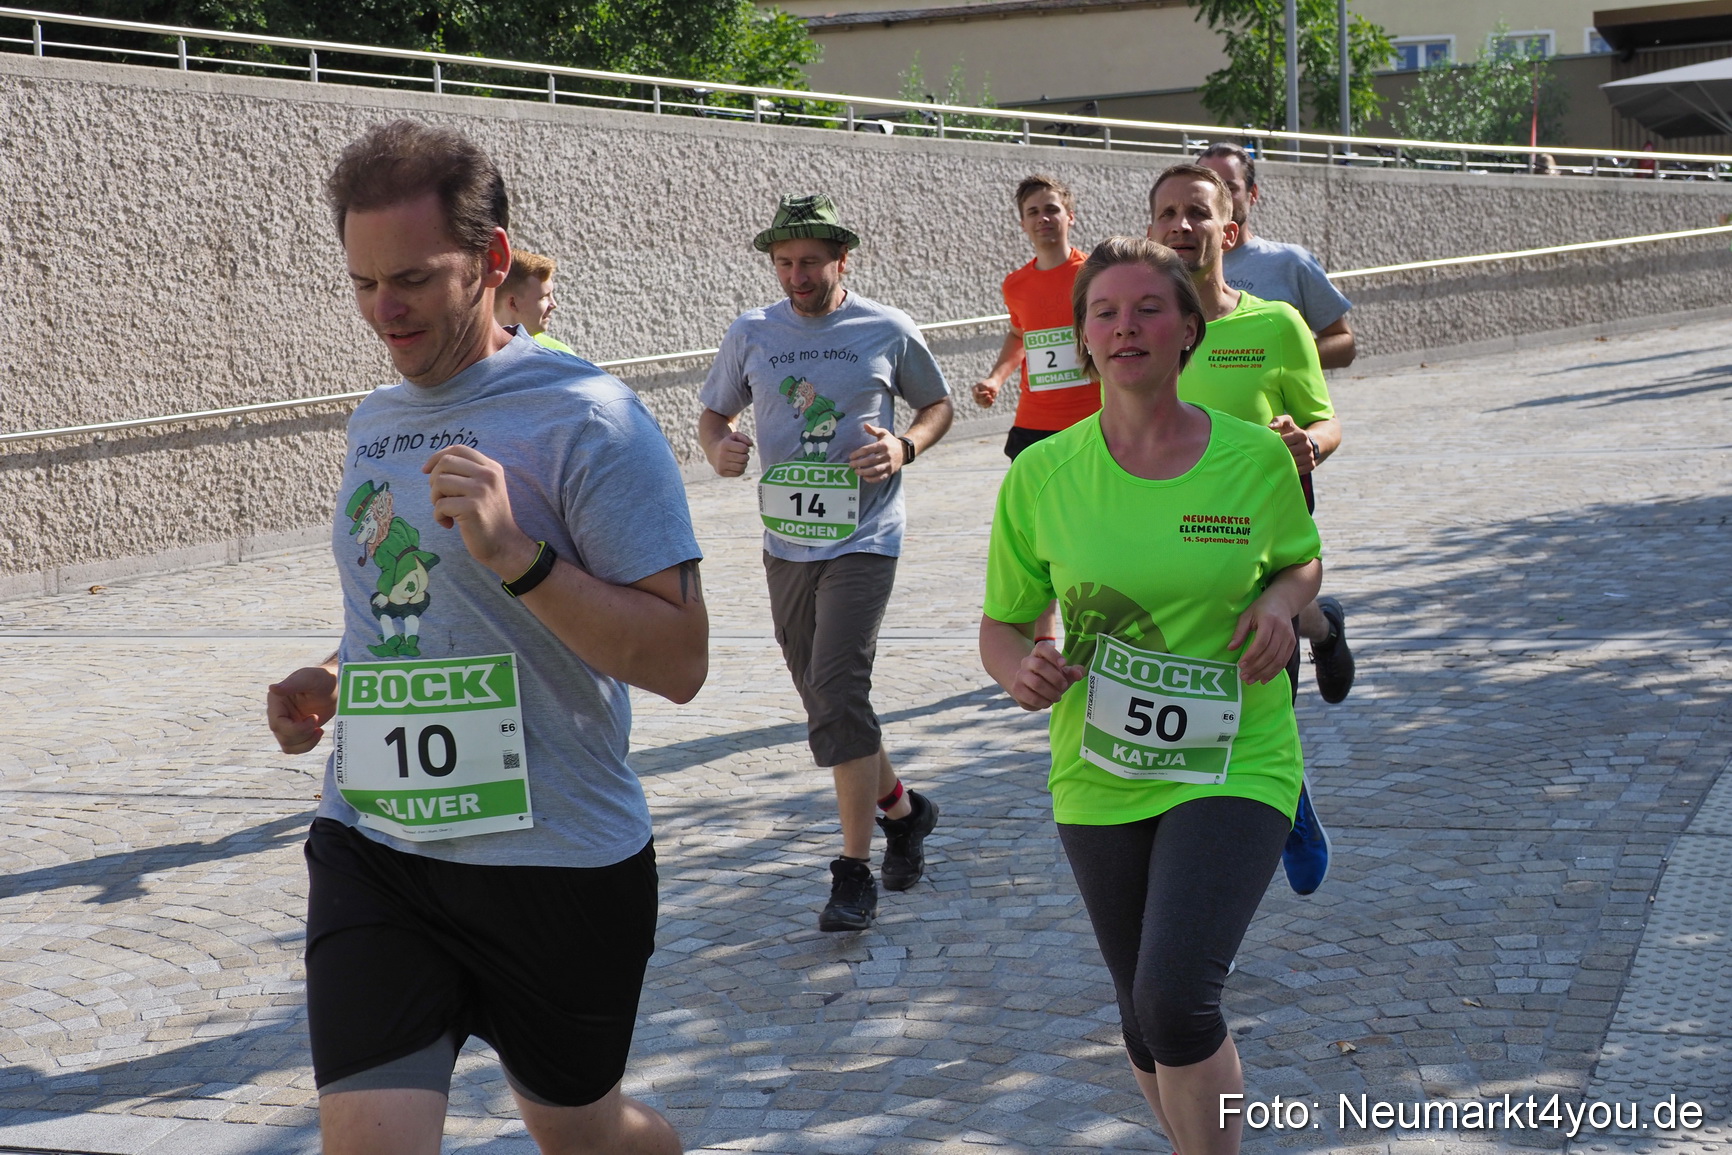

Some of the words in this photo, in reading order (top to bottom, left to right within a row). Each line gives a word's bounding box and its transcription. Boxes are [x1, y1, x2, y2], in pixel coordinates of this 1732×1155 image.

[1225, 278, 1254, 290] hóin
[1026, 328, 1074, 348] BOCK
[769, 352, 795, 369] póg
[799, 349, 819, 361] mo
[823, 348, 859, 364] thóin
[1045, 350, 1058, 368] 2
[1035, 372, 1078, 385] MICHAEL
[354, 435, 391, 468] póg
[392, 433, 424, 454] mo
[768, 465, 851, 486] BOCK
[789, 492, 826, 518] 14
[1182, 514, 1251, 525] NEUMARKTER
[776, 522, 838, 538] JOCHEN
[1179, 525, 1251, 536] ELEMENTELAUF
[1195, 536, 1235, 544] September
[1101, 642, 1228, 696] BOCK
[347, 663, 502, 709] BOCK
[1124, 696, 1188, 742] 50
[1223, 713, 1234, 721] E6
[501, 723, 516, 733] E6
[384, 724, 457, 778] 10
[1112, 742, 1187, 767] KATJA
[375, 793, 481, 820] OLIVER
